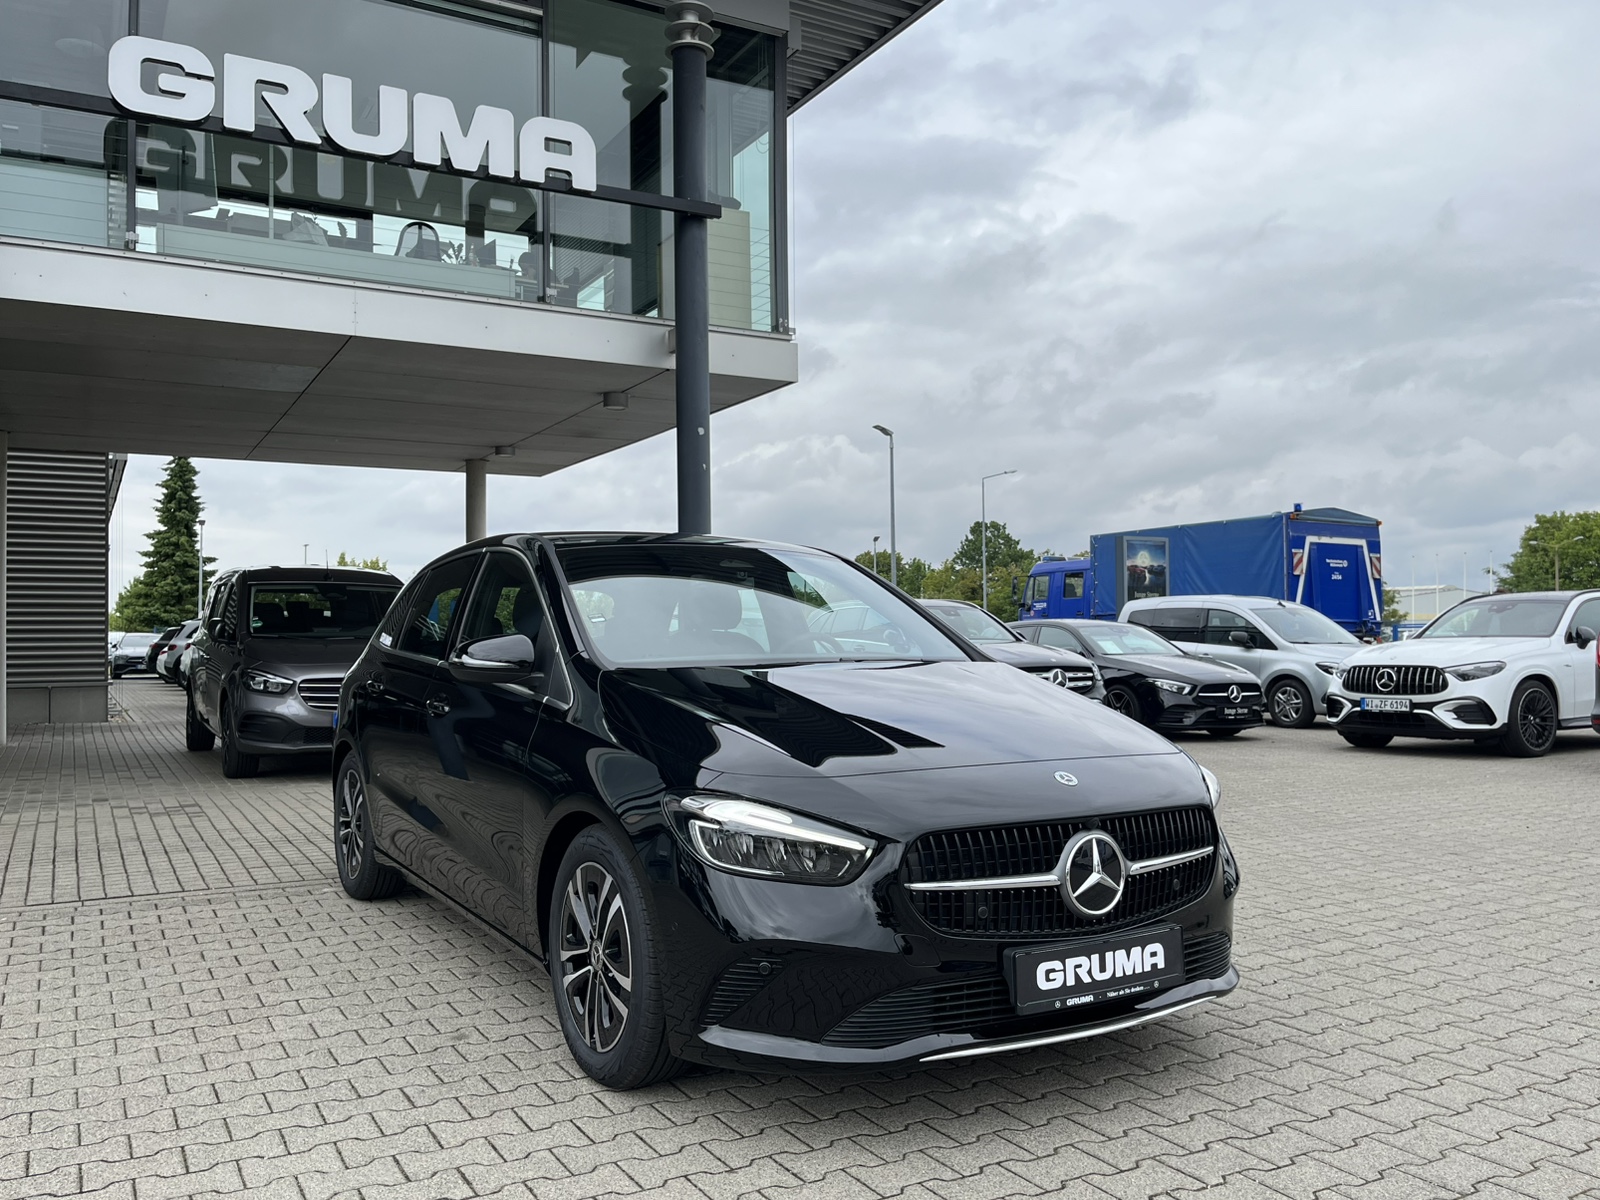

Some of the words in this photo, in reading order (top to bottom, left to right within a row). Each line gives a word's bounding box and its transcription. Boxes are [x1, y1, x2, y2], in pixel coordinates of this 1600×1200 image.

[107, 35, 598, 192] GRUMA
[1379, 700, 1388, 708] ZF
[1389, 700, 1408, 709] 6194
[1036, 942, 1166, 991] GRUMA
[1066, 994, 1094, 1006] GRUMA
